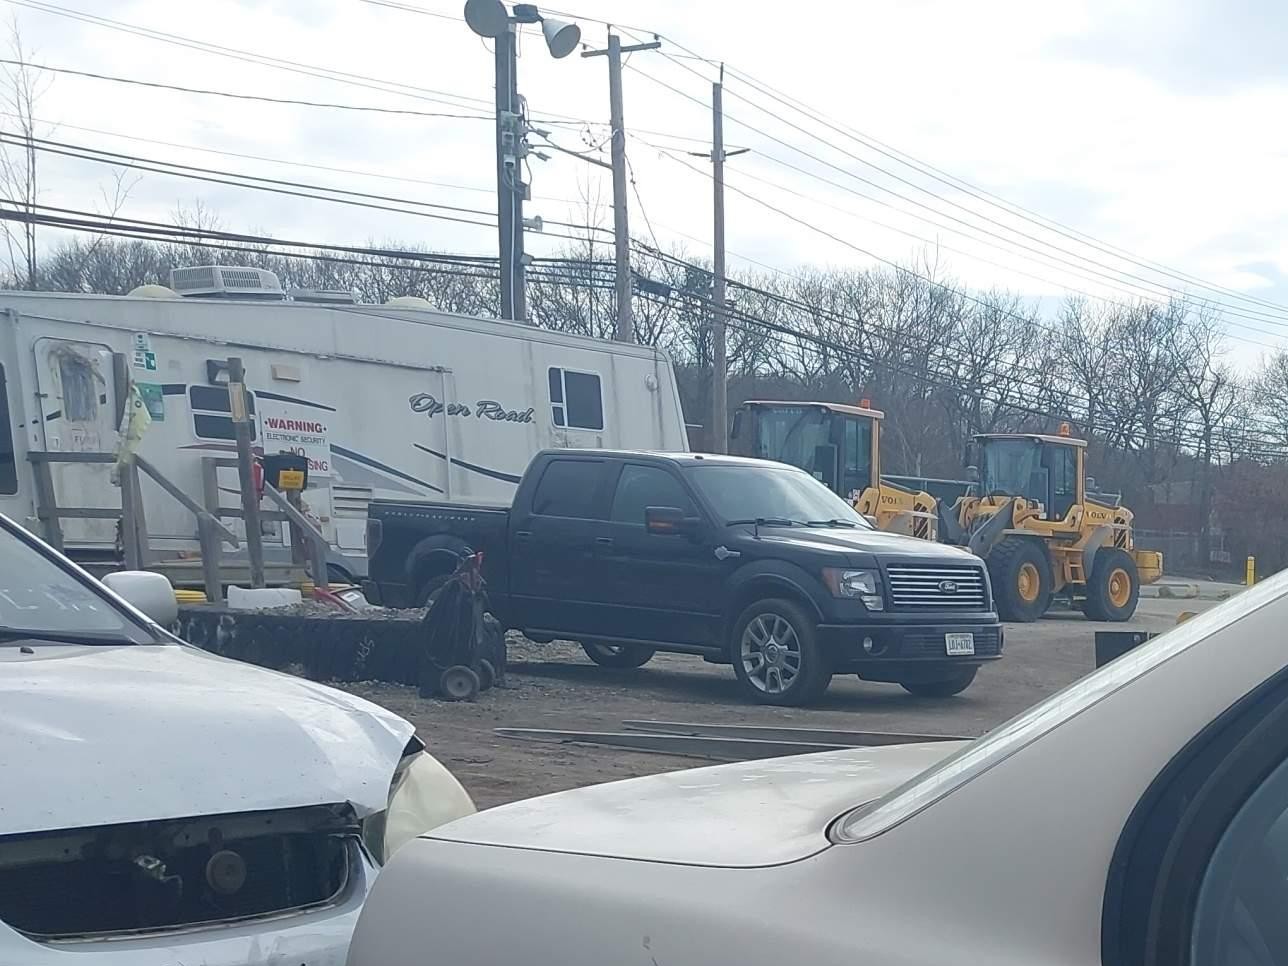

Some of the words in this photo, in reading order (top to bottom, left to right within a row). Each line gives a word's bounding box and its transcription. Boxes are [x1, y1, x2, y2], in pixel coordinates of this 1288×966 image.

[409, 392, 471, 418] Open
[476, 400, 534, 423] Road
[267, 417, 323, 433] WARNING
[266, 432, 298, 442] ELECTRONIC
[300, 436, 326, 444] SECURITY
